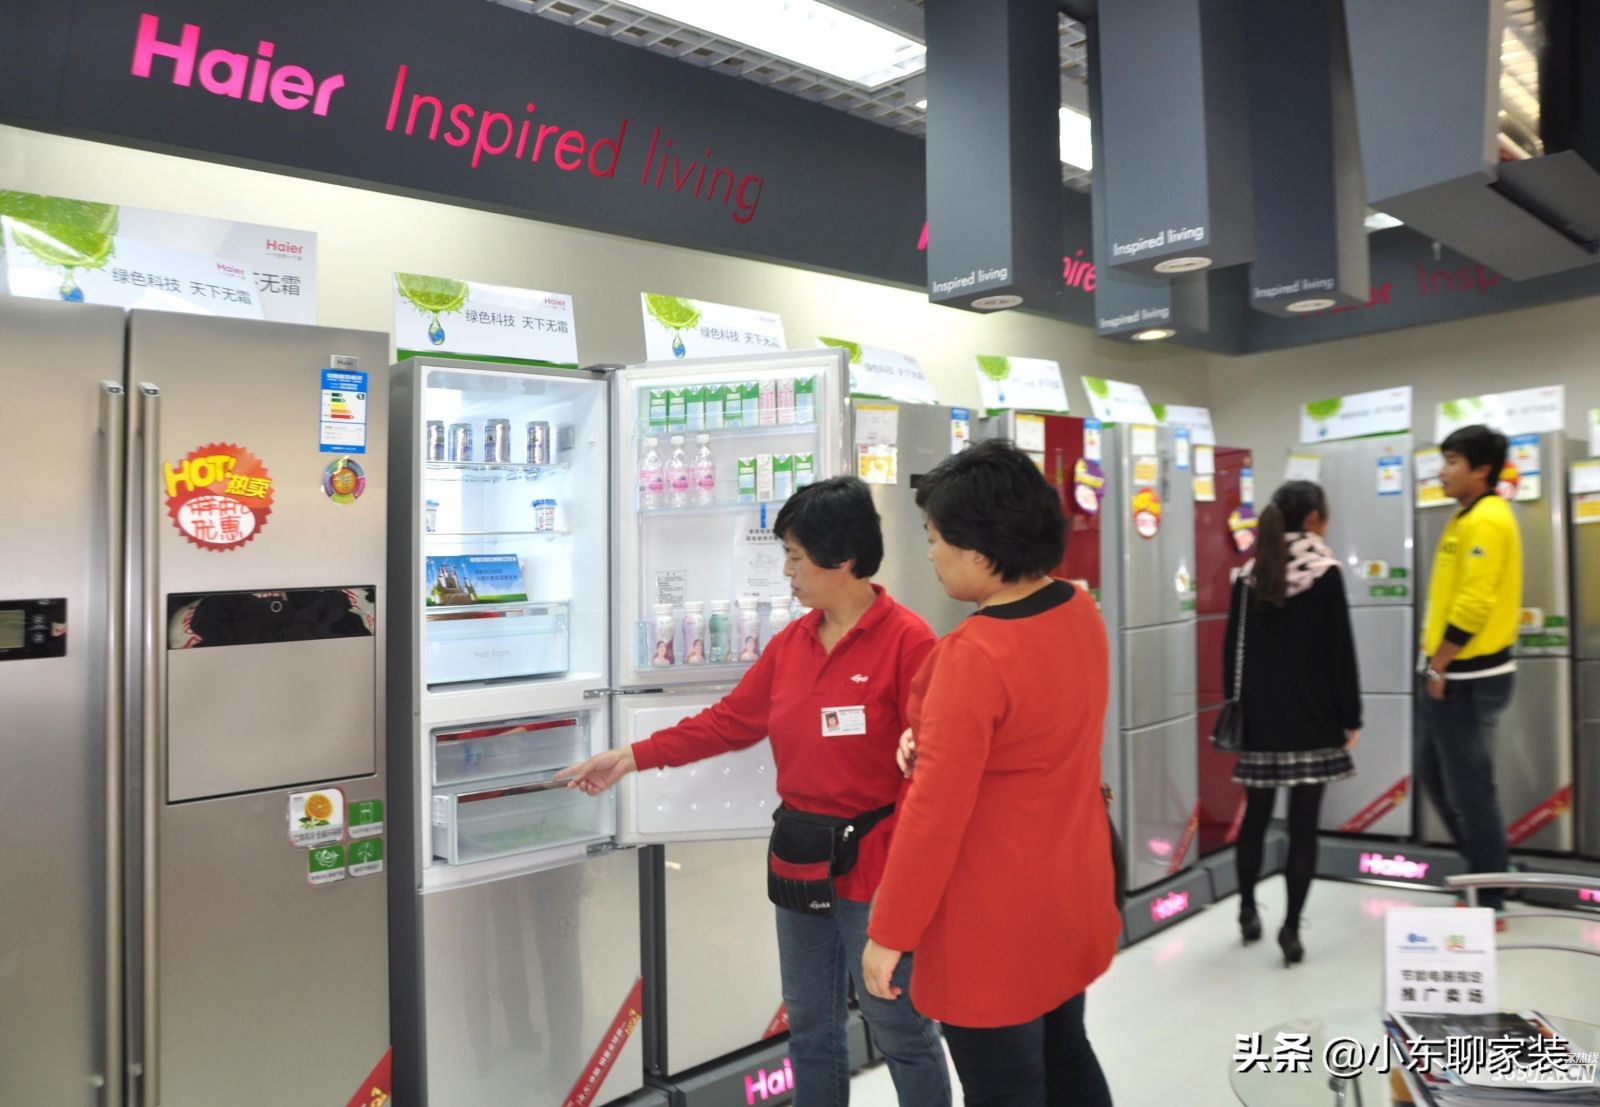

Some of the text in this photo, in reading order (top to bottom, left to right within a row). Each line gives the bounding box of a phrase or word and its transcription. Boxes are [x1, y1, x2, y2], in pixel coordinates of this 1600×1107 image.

[130, 13, 766, 225] Haier Inspired living
[265, 238, 304, 254] Haier
[1112, 224, 1205, 258] Inspired living
[216, 262, 246, 276] Haier
[932, 264, 1009, 294] Inspired living
[112, 266, 253, 306] 绿色科技 天下无霜
[1253, 275, 1335, 299] Inspired living
[465, 308, 569, 334] 绿色科技 天下无霜
[1099, 305, 1170, 329] Inspired living
[699, 325, 739, 342] 绿色科技
[164, 455, 237, 497] HOT!
[225, 475, 271, 500] 热卖
[191, 514, 243, 542] 优惠
[1359, 852, 1428, 880] Haier
[743, 1056, 795, 1105] Hai
